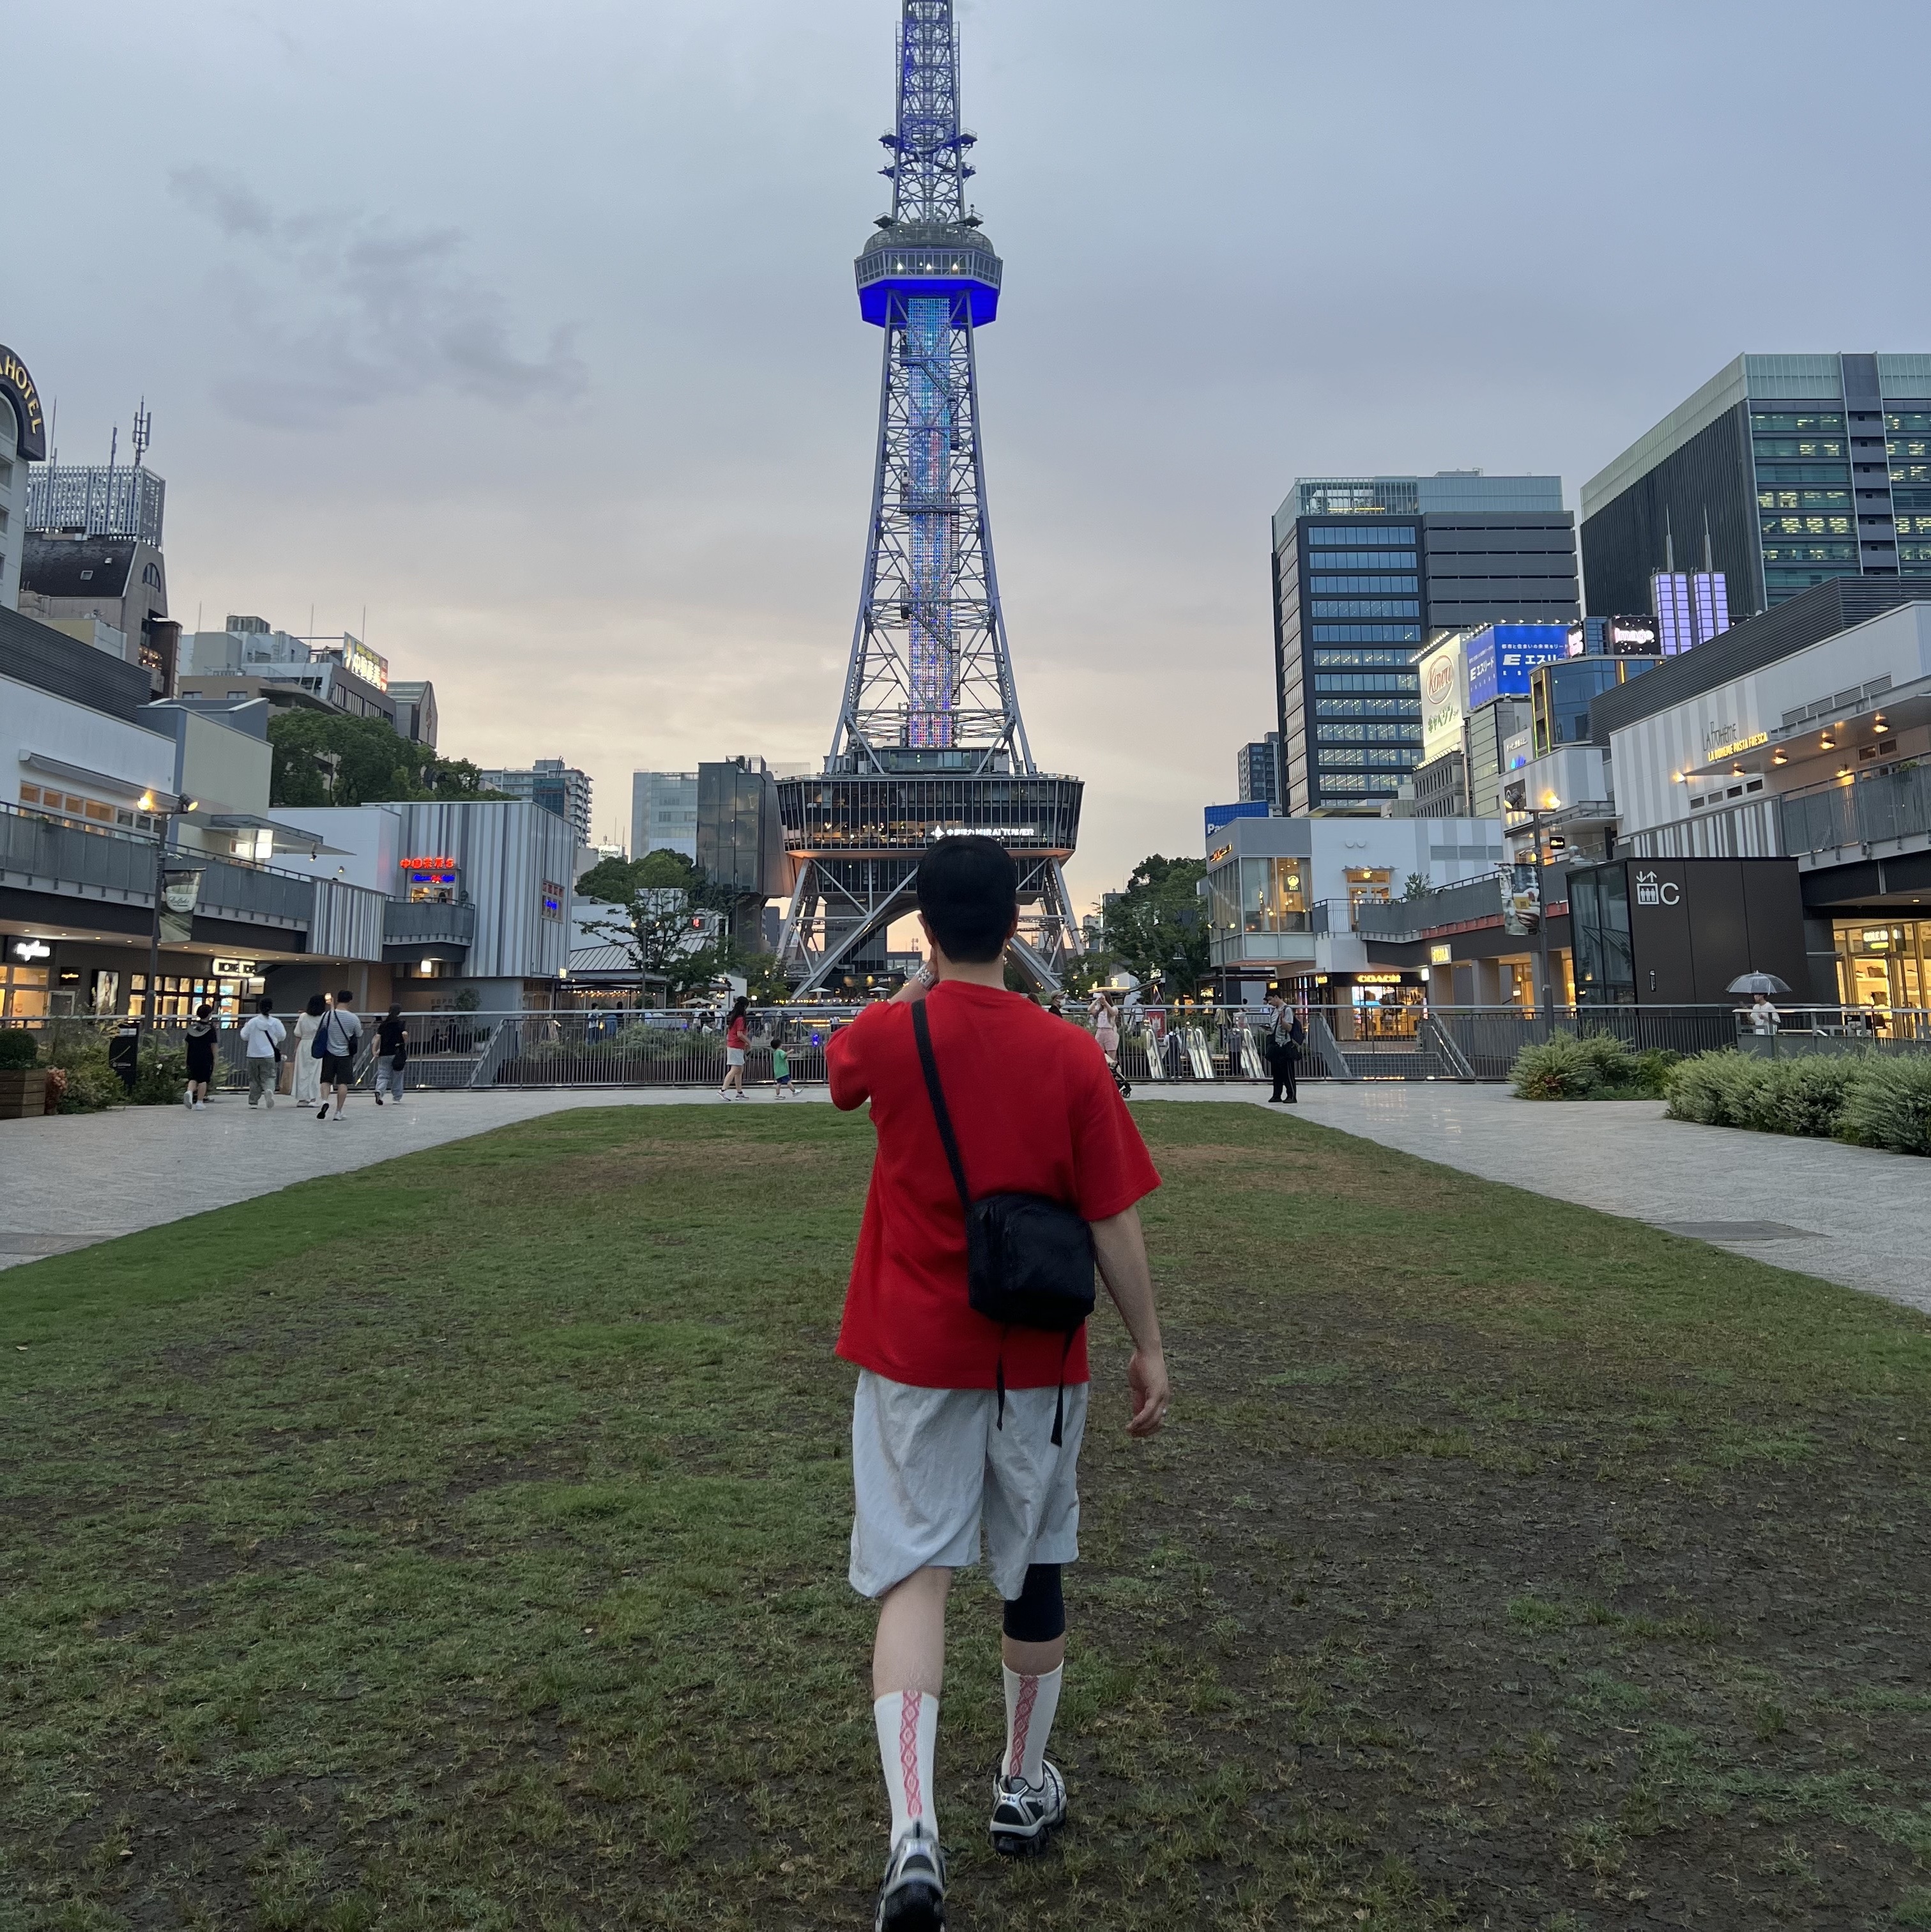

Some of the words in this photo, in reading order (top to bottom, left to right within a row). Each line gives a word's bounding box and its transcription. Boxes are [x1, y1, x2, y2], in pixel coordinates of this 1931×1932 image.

[4, 355, 42, 434] HOTEL
[1428, 704, 1453, 733] キャベジン
[1707, 750, 1715, 762] LA
[1733, 738, 1749, 753] PASTA
[1748, 731, 1768, 747] FRESCA
[1660, 882, 1680, 905] C
[1357, 974, 1401, 983] COACH
